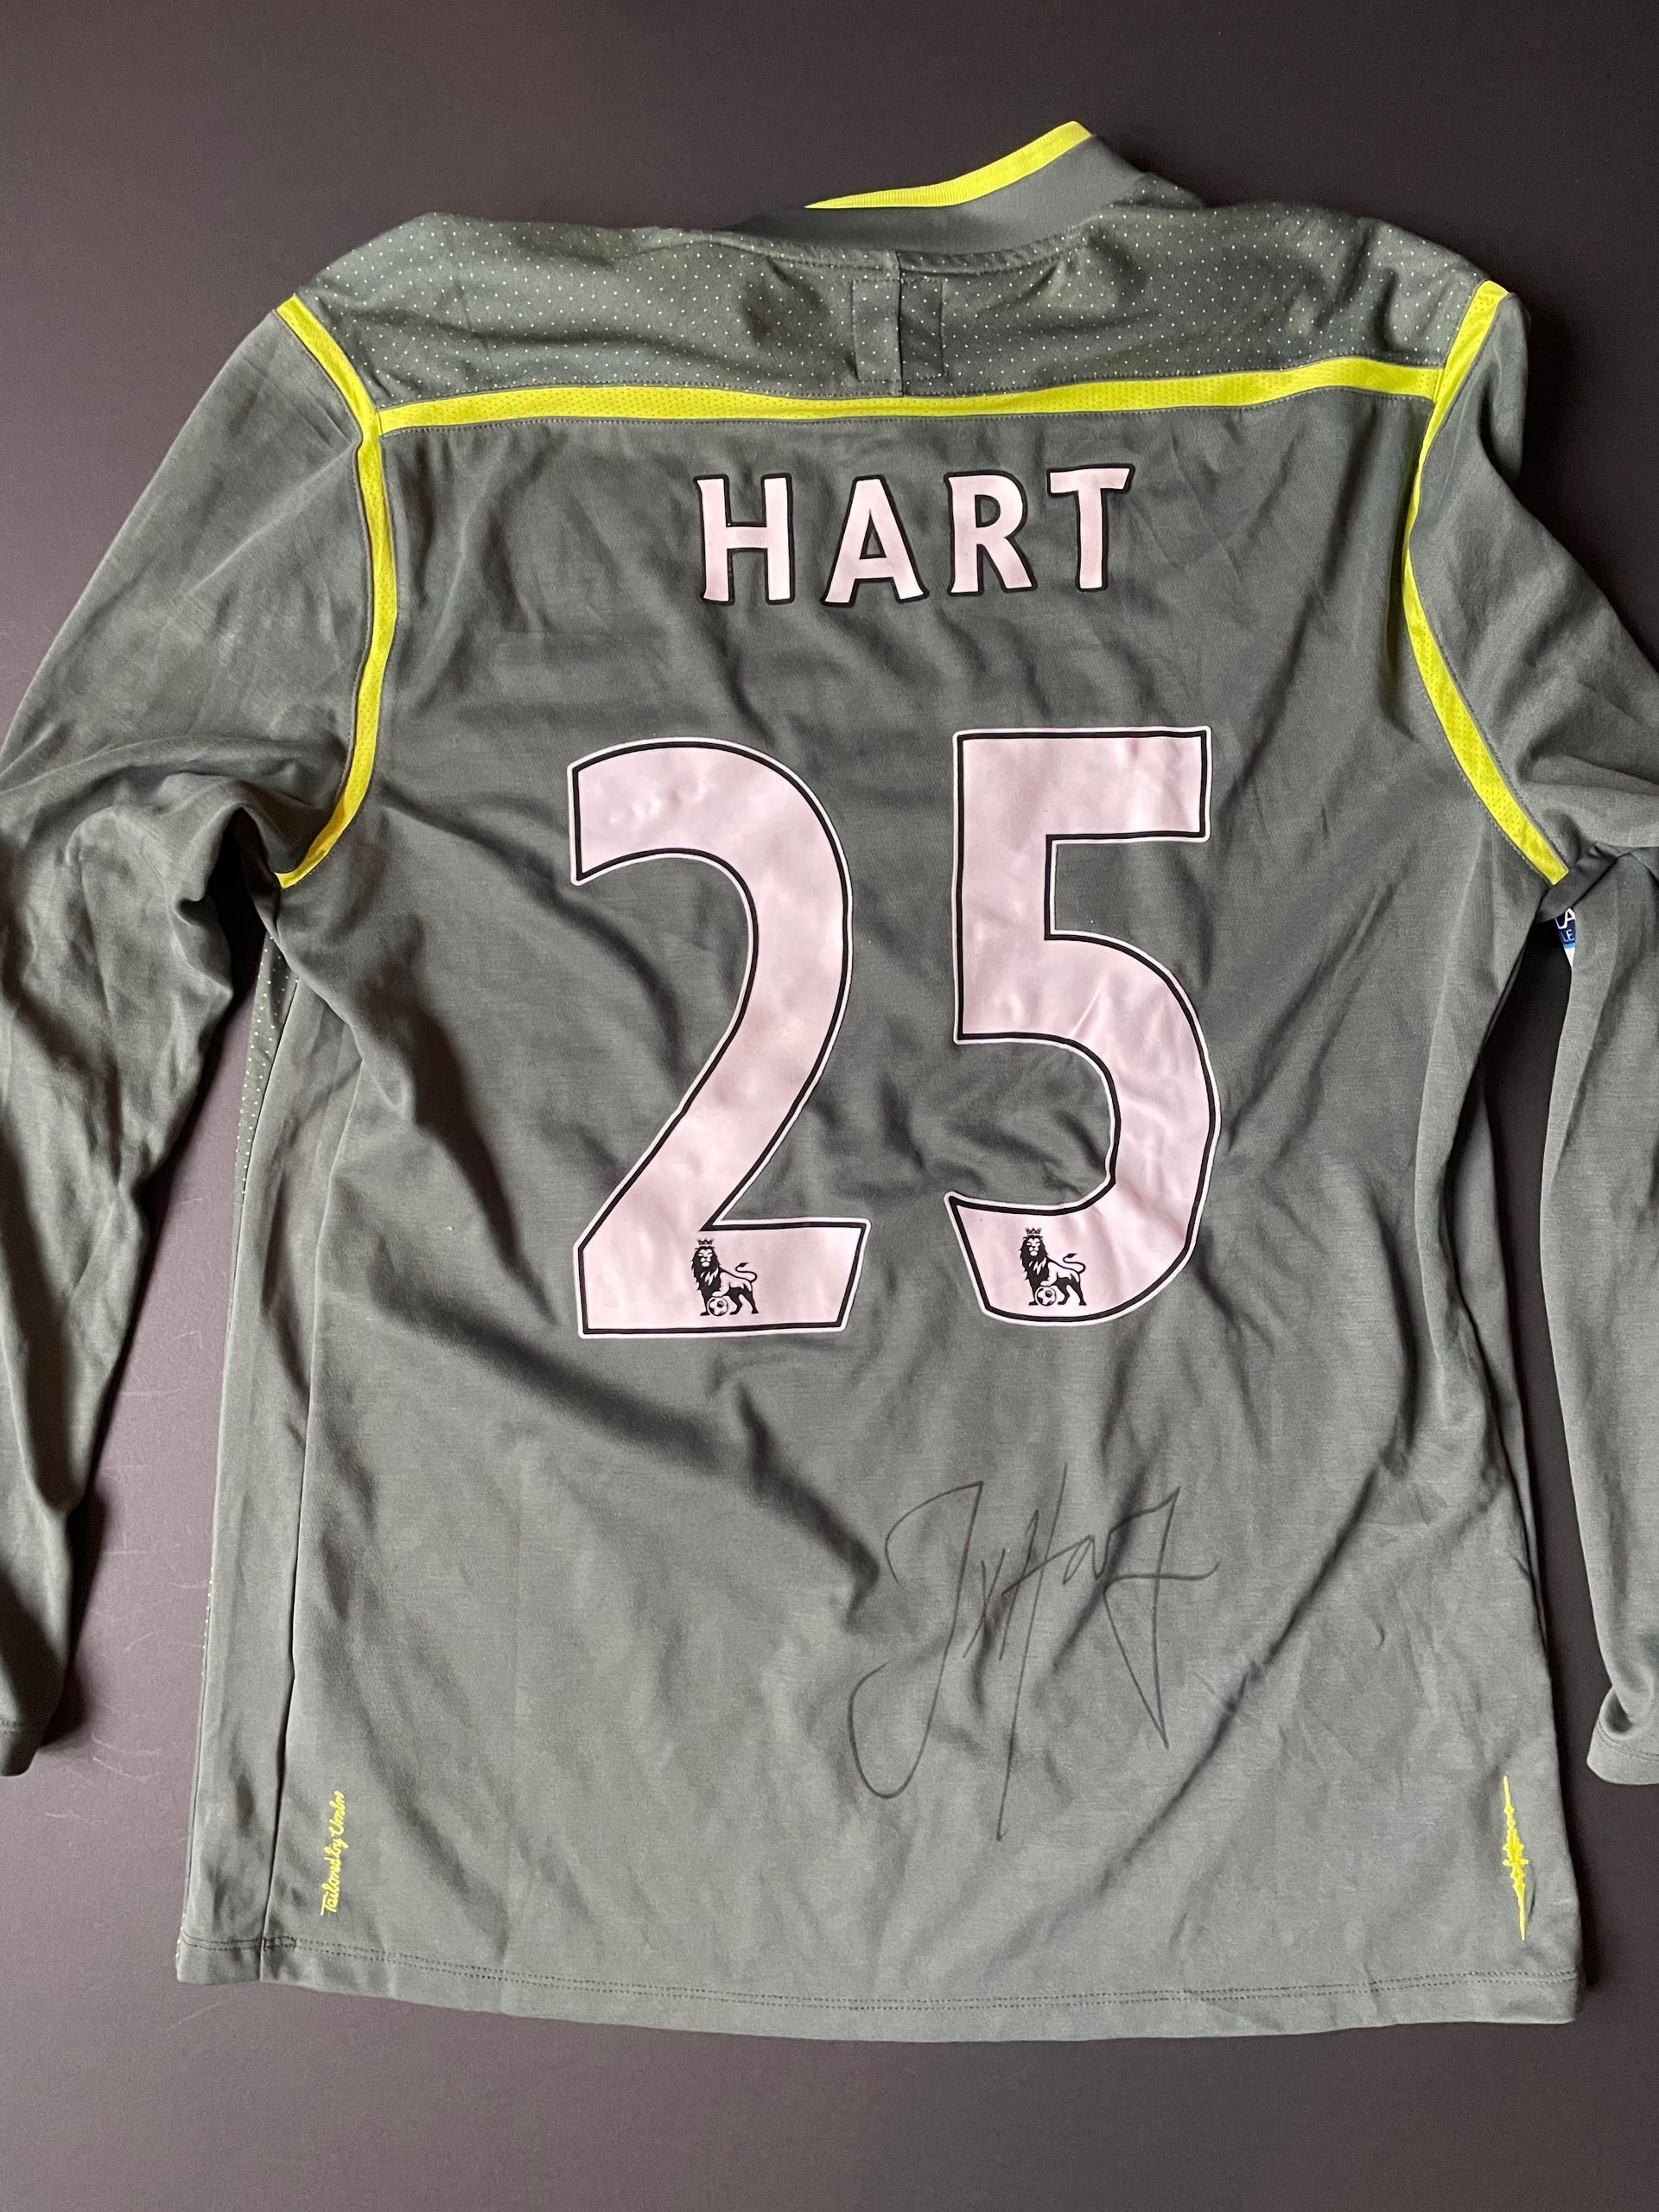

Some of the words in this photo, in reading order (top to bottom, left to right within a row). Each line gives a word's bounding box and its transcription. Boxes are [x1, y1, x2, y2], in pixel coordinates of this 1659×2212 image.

[694, 463, 1135, 607] HART
[568, 727, 1221, 1338] 25
[324, 1838, 349, 1857] by
